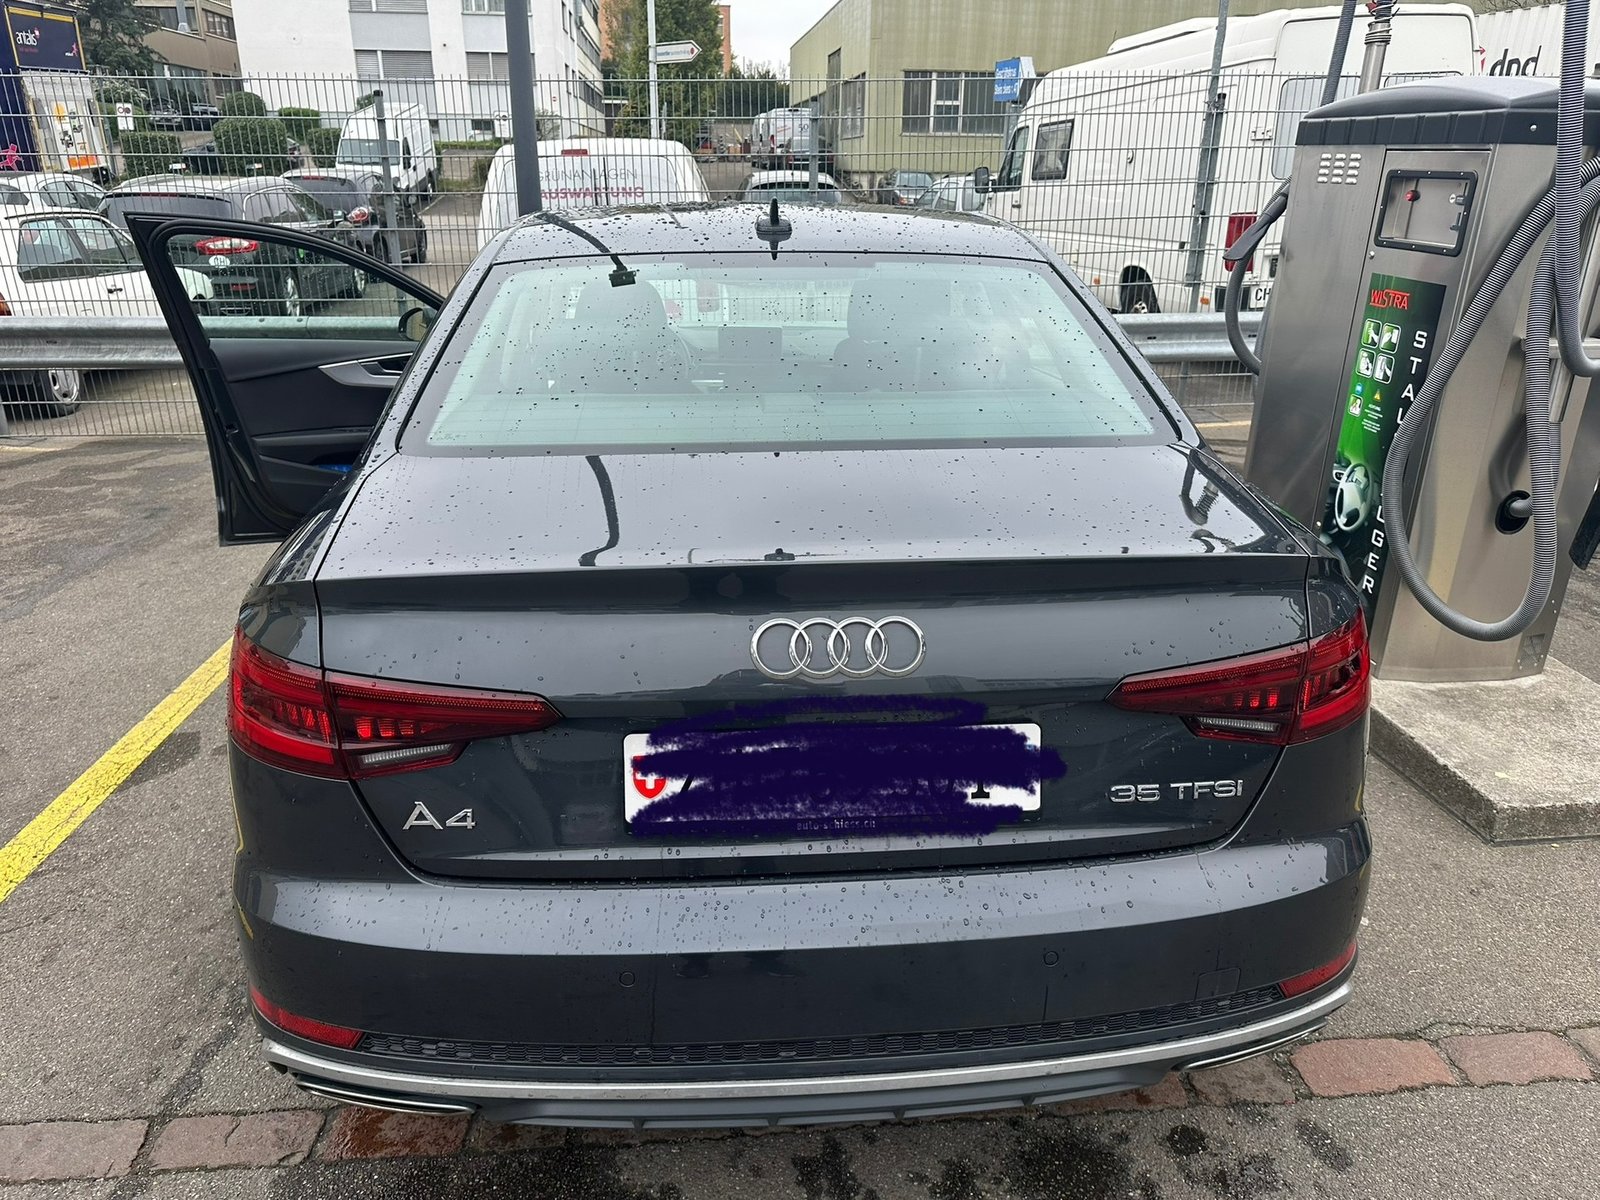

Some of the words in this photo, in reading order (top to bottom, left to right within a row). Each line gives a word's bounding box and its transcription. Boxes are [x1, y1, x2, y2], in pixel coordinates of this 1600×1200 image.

[1369, 289, 1410, 310] WISTRA
[1110, 783, 1161, 803] 35
[1168, 779, 1244, 800] TFSI
[402, 801, 476, 830] A4
